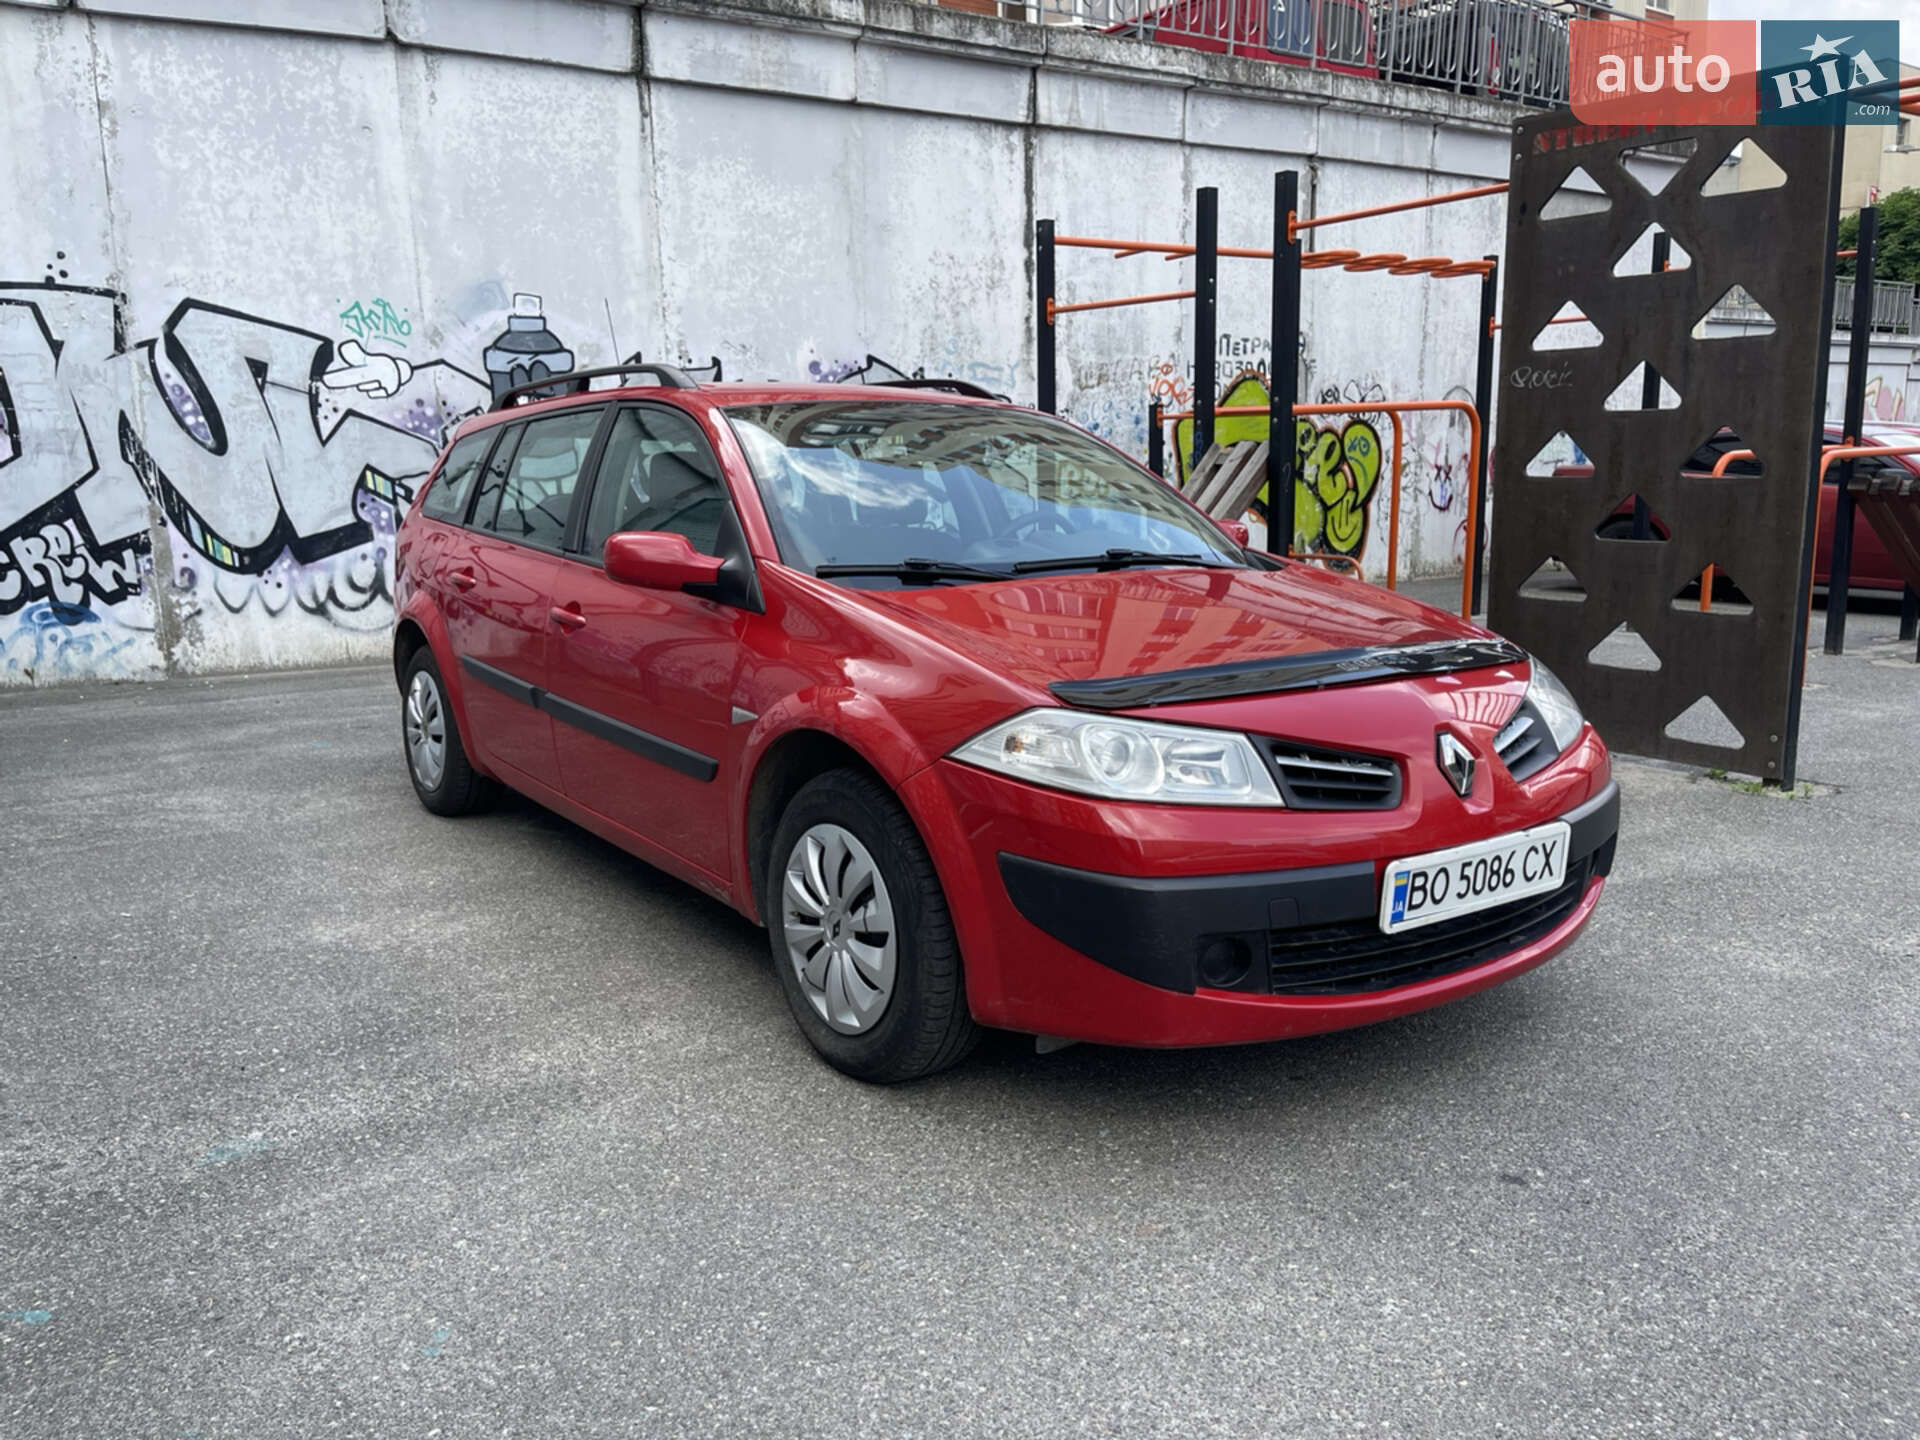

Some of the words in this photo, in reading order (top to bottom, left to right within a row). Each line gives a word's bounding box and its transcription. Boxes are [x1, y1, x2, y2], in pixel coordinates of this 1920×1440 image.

[1408, 866, 1450, 912] BO
[1456, 850, 1516, 899] 5086
[1523, 840, 1558, 882] CX
